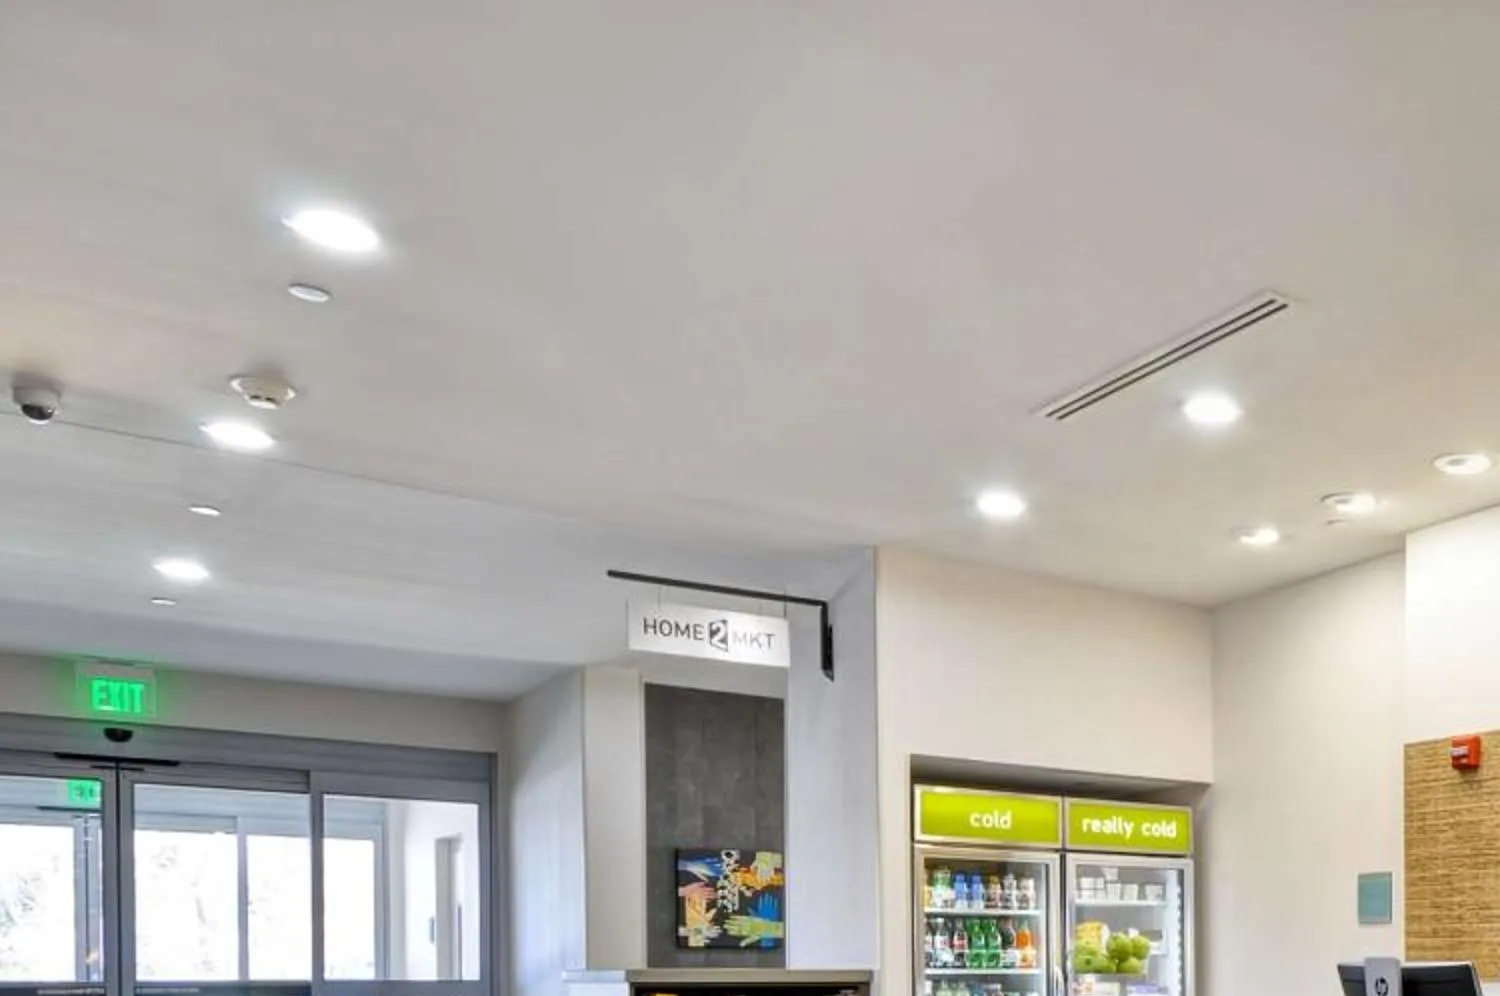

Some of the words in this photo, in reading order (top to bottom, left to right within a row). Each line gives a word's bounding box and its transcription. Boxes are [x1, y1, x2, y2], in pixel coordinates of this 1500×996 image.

[732, 632, 775, 649] MKT
[91, 679, 145, 713] EXIT
[969, 810, 1012, 829] cold
[1082, 816, 1134, 839] really
[1141, 821, 1177, 838] cold
